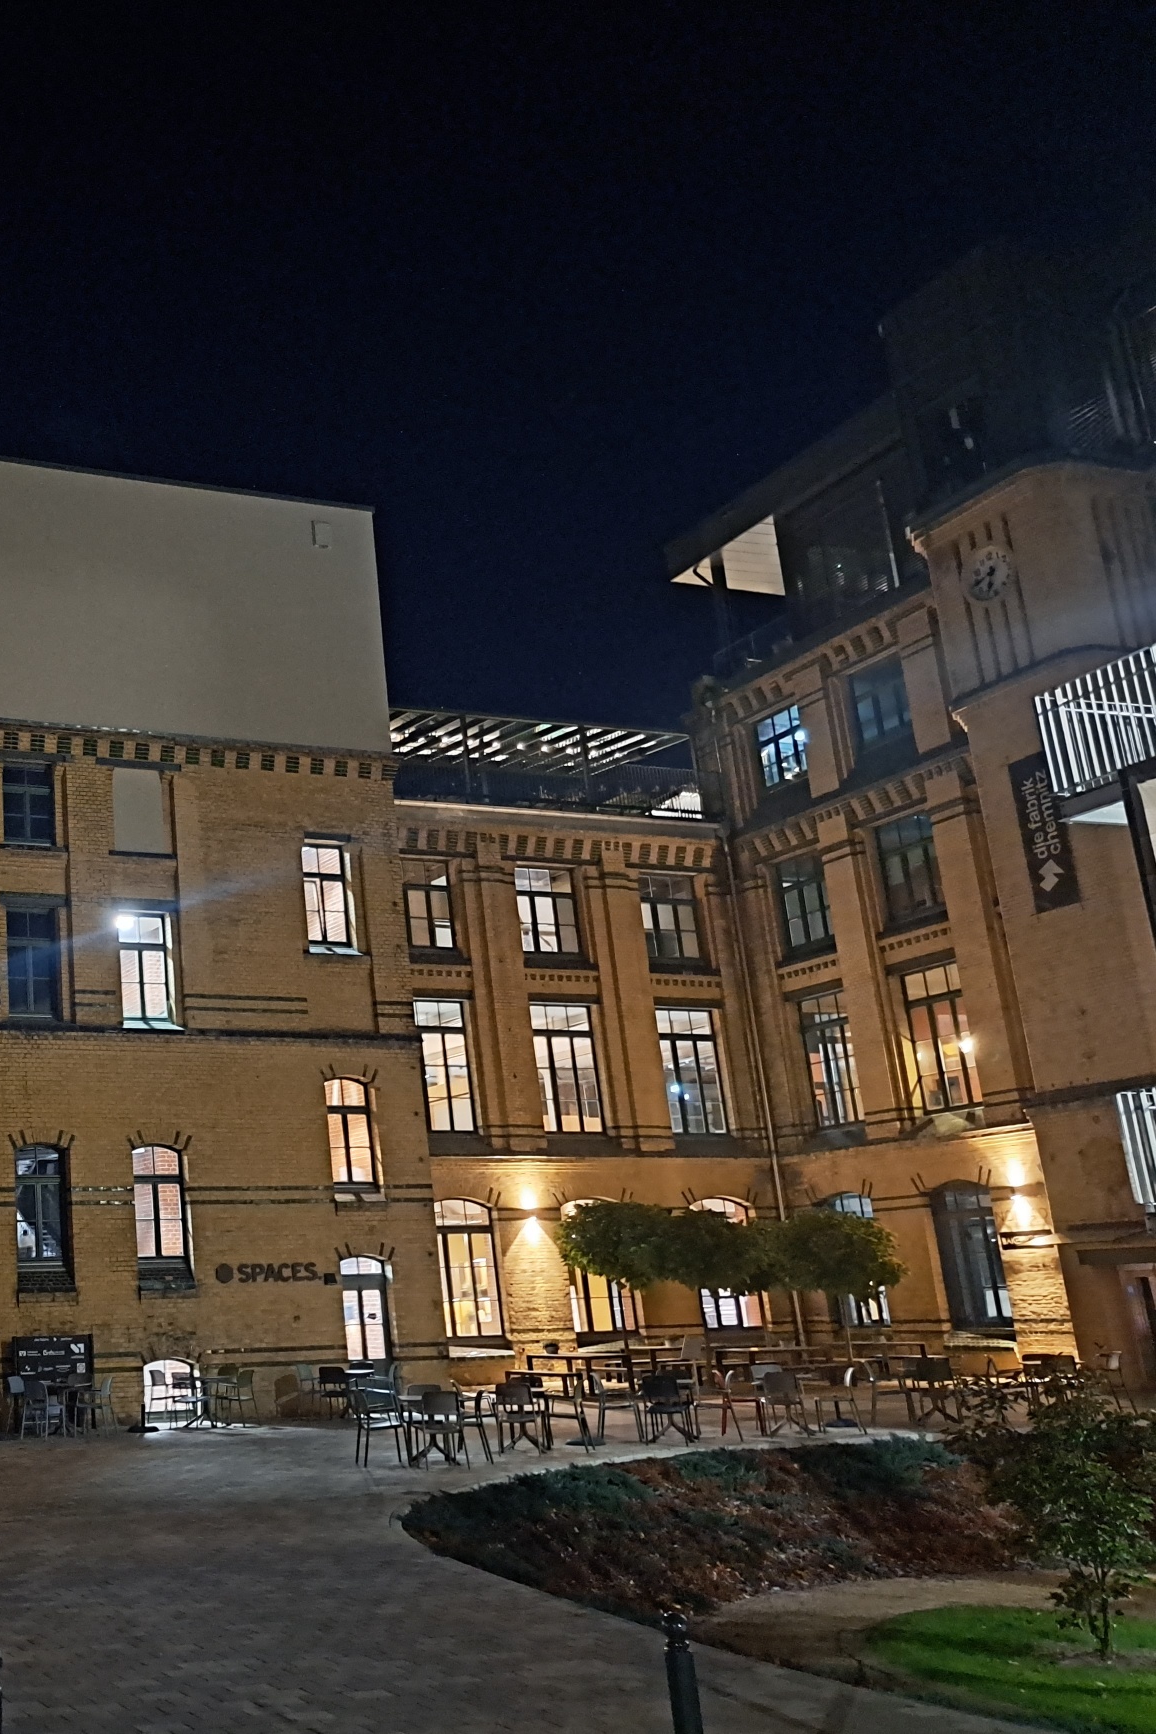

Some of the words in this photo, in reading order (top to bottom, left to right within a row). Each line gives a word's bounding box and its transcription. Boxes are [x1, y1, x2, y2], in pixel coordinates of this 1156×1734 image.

[1021, 776, 1042, 831] fabrik
[1035, 768, 1061, 854] chemnitz
[1032, 831, 1048, 859] die
